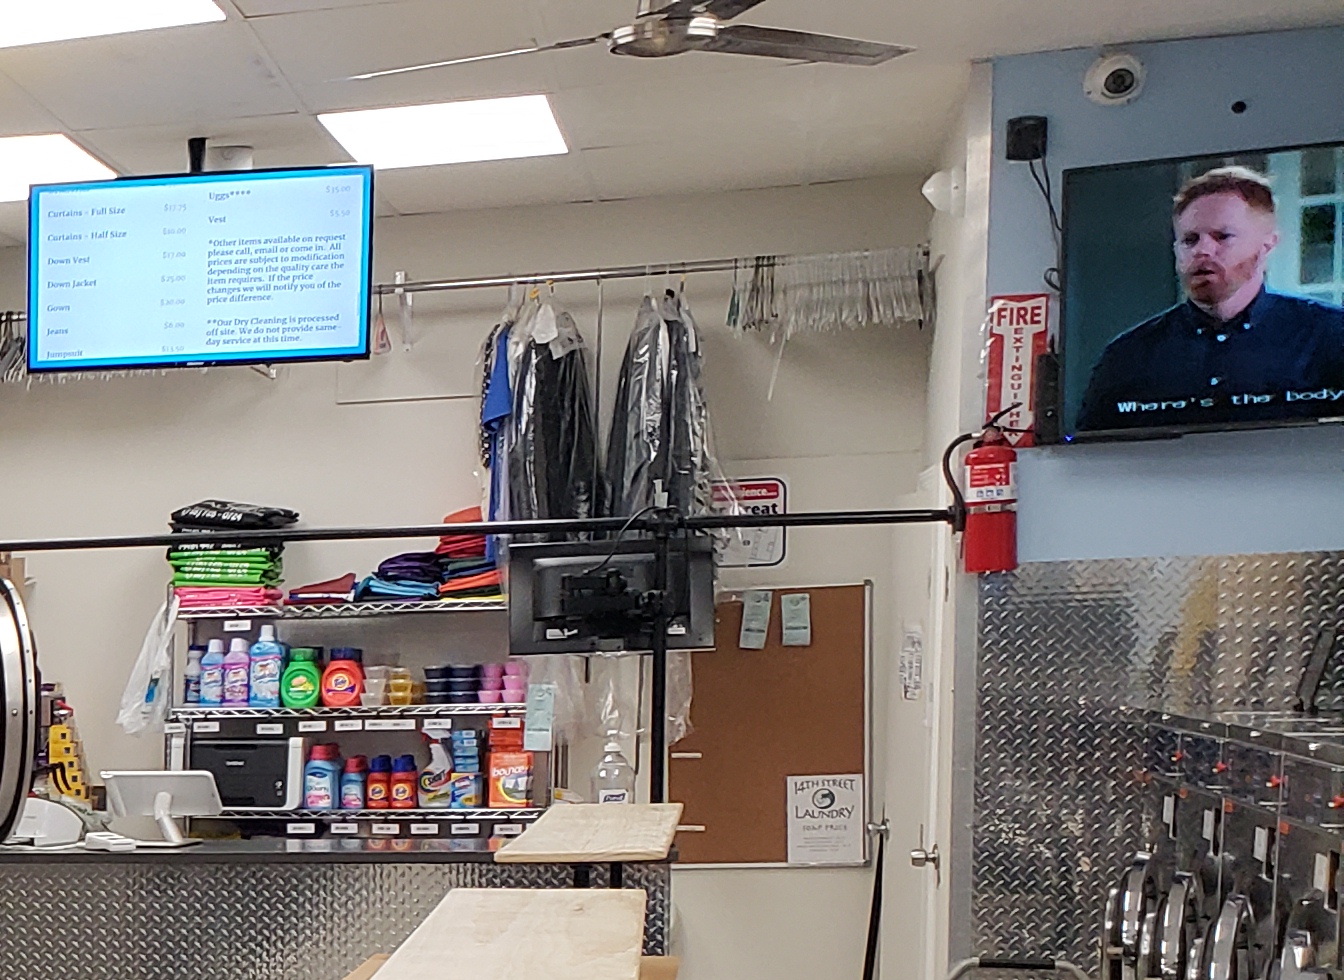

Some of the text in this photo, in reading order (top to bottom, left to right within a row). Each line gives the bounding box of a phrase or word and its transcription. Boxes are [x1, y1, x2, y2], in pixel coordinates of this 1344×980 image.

[48, 208, 82, 218] Curtains
[47, 232, 82, 242] Curtains
[91, 231, 108, 239] Half
[263, 235, 300, 244] available
[315, 234, 346, 242] request
[208, 249, 234, 259] please
[254, 246, 278, 255] email
[47, 256, 90, 265] Down Vest
[208, 258, 232, 267] prices
[250, 255, 278, 265] subject
[291, 253, 345, 262] modification
[207, 267, 251, 276] depending
[281, 264, 309, 274] quality
[47, 279, 97, 289] Down Jacket
[207, 277, 226, 285] item
[269, 274, 275, 282] If
[292, 273, 313, 283] price
[207, 286, 241, 295] changes
[256, 284, 271, 292] will
[273, 282, 298, 292] notify
[299, 282, 315, 291] you
[317, 281, 326, 289] of
[207, 296, 227, 305] price
[234, 319, 249, 327] Dry
[250, 316, 287, 325] Cleaning
[298, 314, 339, 324] processed
[996, 305, 1043, 327] FIRE
[46, 328, 68, 336] Jeans
[206, 328, 218, 336] off
[253, 326, 264, 334] do
[266, 326, 280, 334] not
[282, 324, 314, 334] provide
[206, 337, 221, 346] day
[222, 337, 251, 345] service
[263, 334, 278, 343] this
[46, 350, 83, 359] Jumpsuit
[1117, 397, 1214, 412] Where's
[1231, 393, 1275, 405] the
[794, 779, 856, 795] 14TH STREET
[795, 804, 855, 819] LAUNDRY
